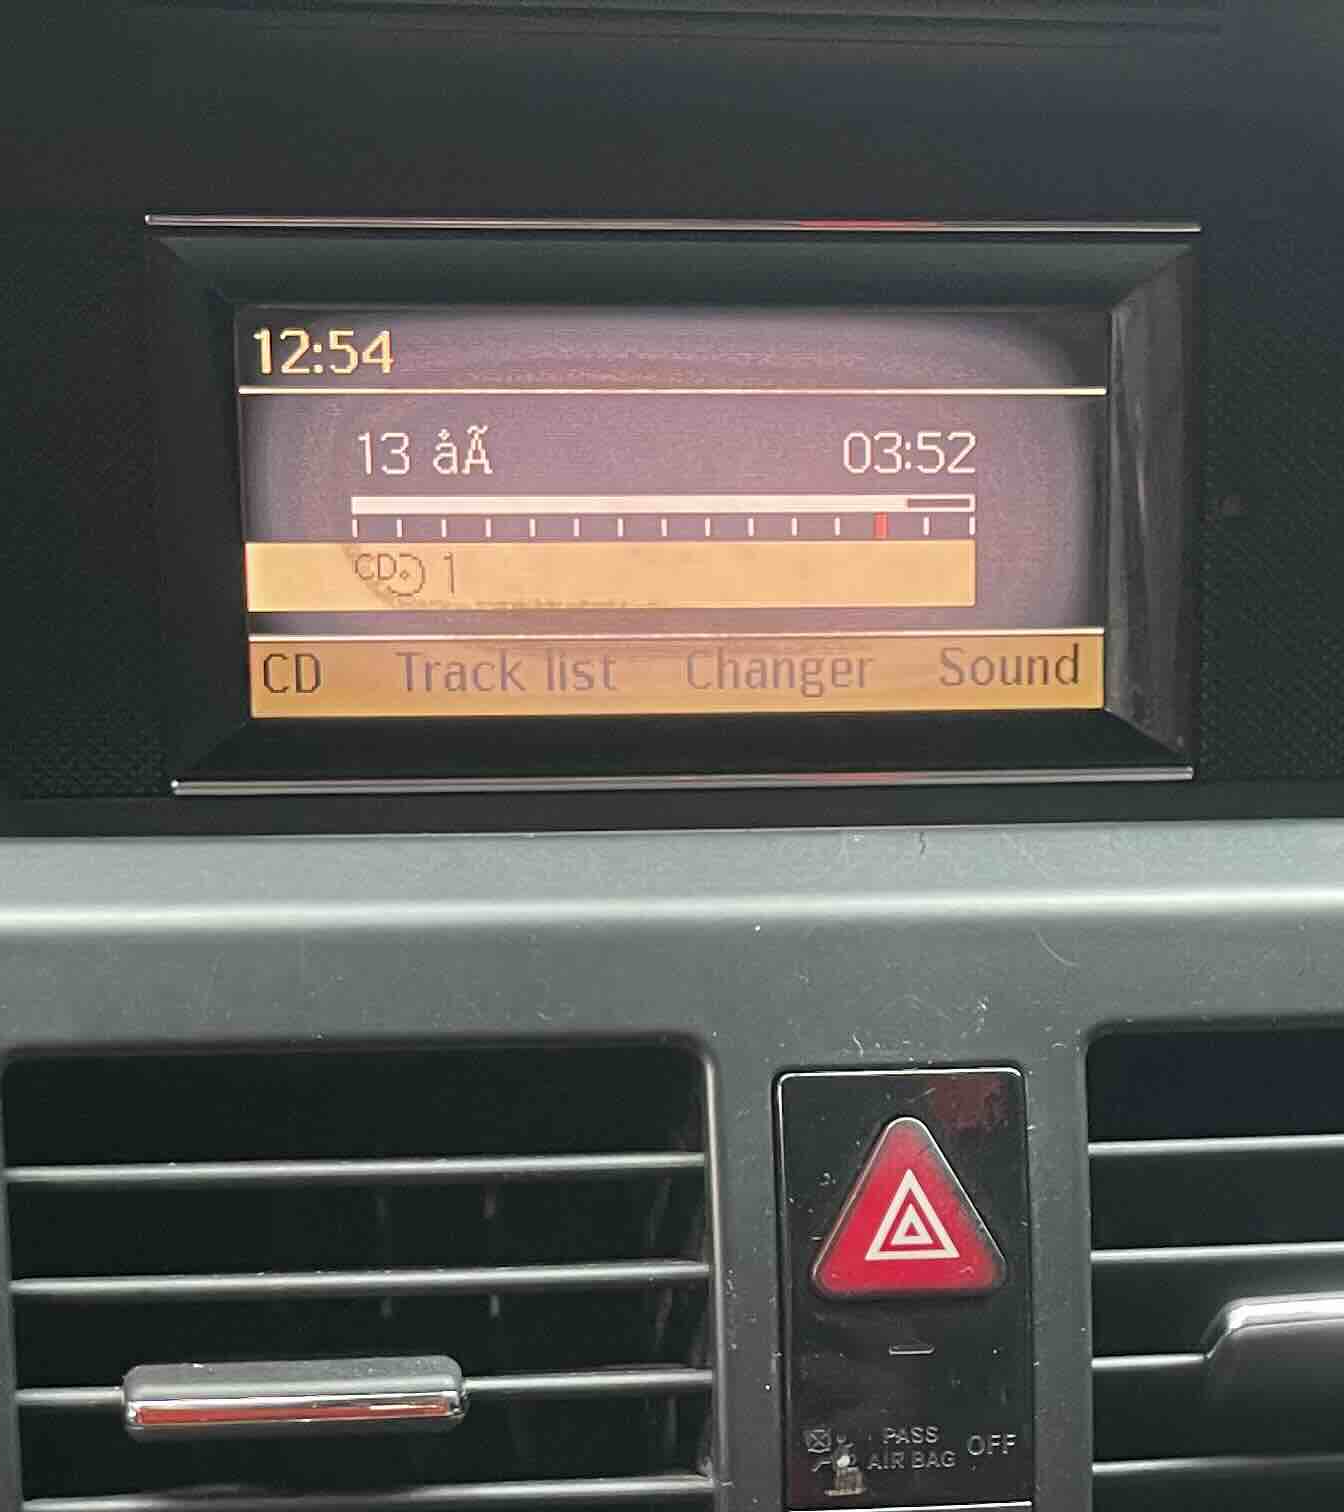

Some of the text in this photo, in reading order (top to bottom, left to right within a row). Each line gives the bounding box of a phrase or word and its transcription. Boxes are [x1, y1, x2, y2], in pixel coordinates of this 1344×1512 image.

[252, 327, 396, 375] 12:54
[357, 431, 410, 476] 13
[842, 431, 977, 476] 03:52
[443, 552, 455, 594] 1
[262, 652, 323, 695] CD
[396, 646, 617, 693] Track list
[685, 646, 876, 700] Changer
[938, 642, 1082, 686] Sound
[883, 1426, 939, 1444] PASS
[967, 1434, 1016, 1455] OFF
[867, 1450, 957, 1470] AIR BAG
